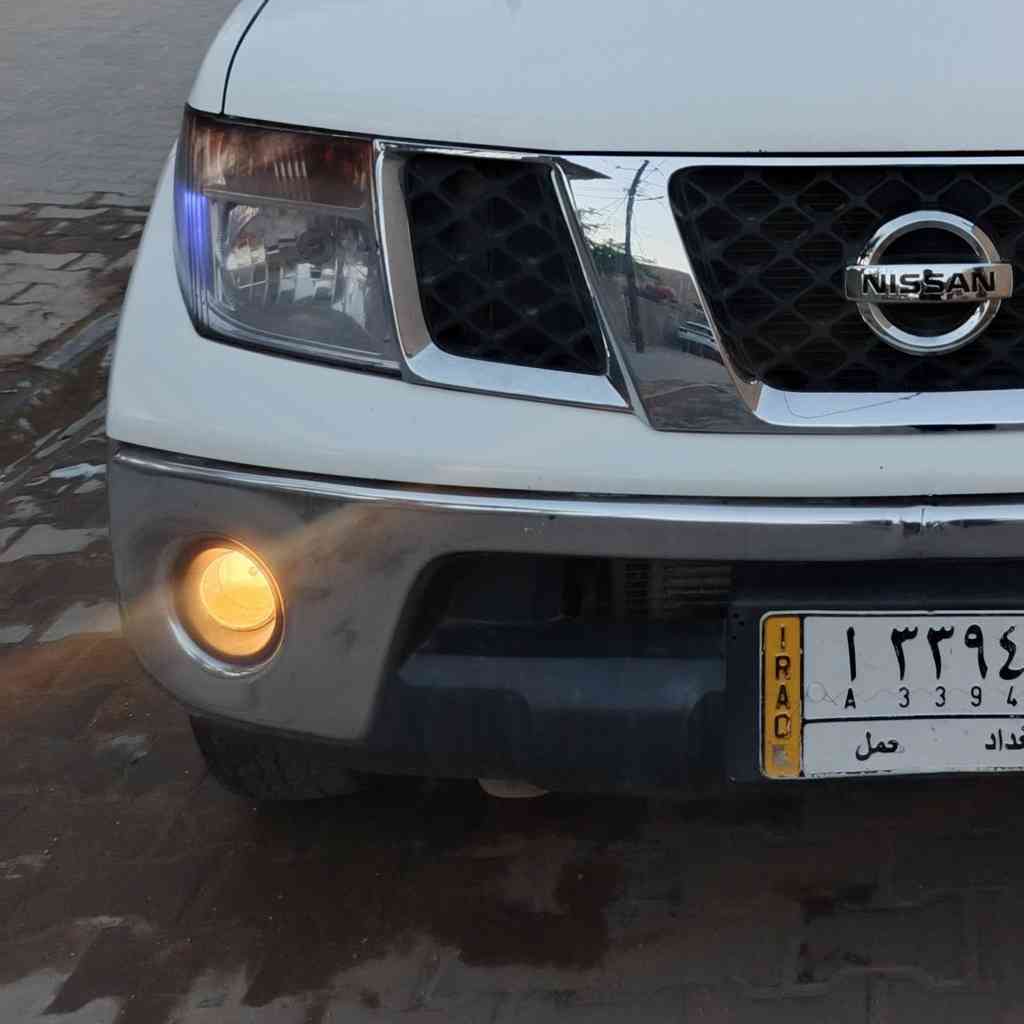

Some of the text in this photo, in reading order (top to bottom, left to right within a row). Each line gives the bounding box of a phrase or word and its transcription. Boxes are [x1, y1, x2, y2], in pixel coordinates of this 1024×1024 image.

[862, 271, 995, 294] NISSAN
[844, 687, 857, 710] A
[855, 731, 900, 762] حمل
